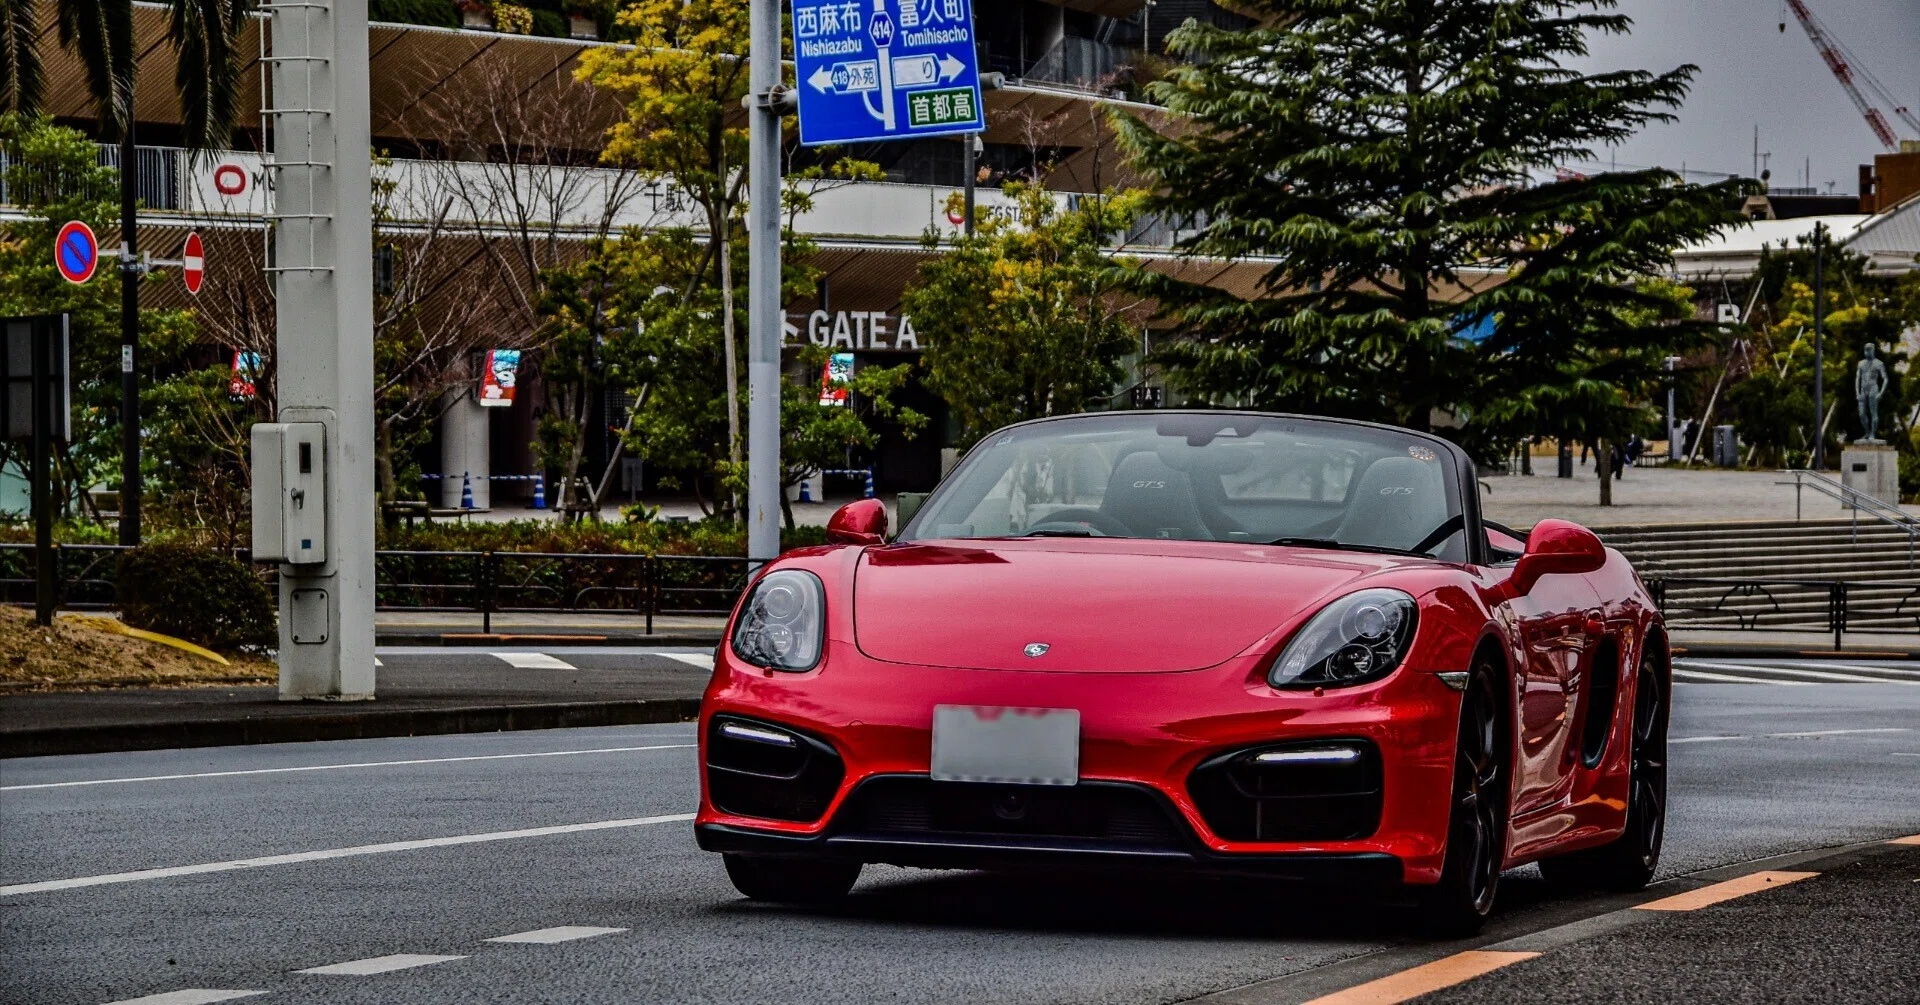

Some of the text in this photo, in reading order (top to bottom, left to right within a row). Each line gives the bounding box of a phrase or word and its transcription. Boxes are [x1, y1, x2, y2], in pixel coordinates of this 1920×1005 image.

[798, 3, 862, 37] 西麻布
[872, 22, 891, 39] 414
[801, 36, 862, 57] Nishiazabu
[900, 25, 968, 47] Tomihisacho
[832, 65, 875, 86] 418 外苑
[912, 92, 972, 122] 首都高
[808, 309, 888, 349] GATE
[894, 313, 919, 349] A
[1133, 480, 1166, 489] GTS
[1380, 486, 1414, 495] GTS
